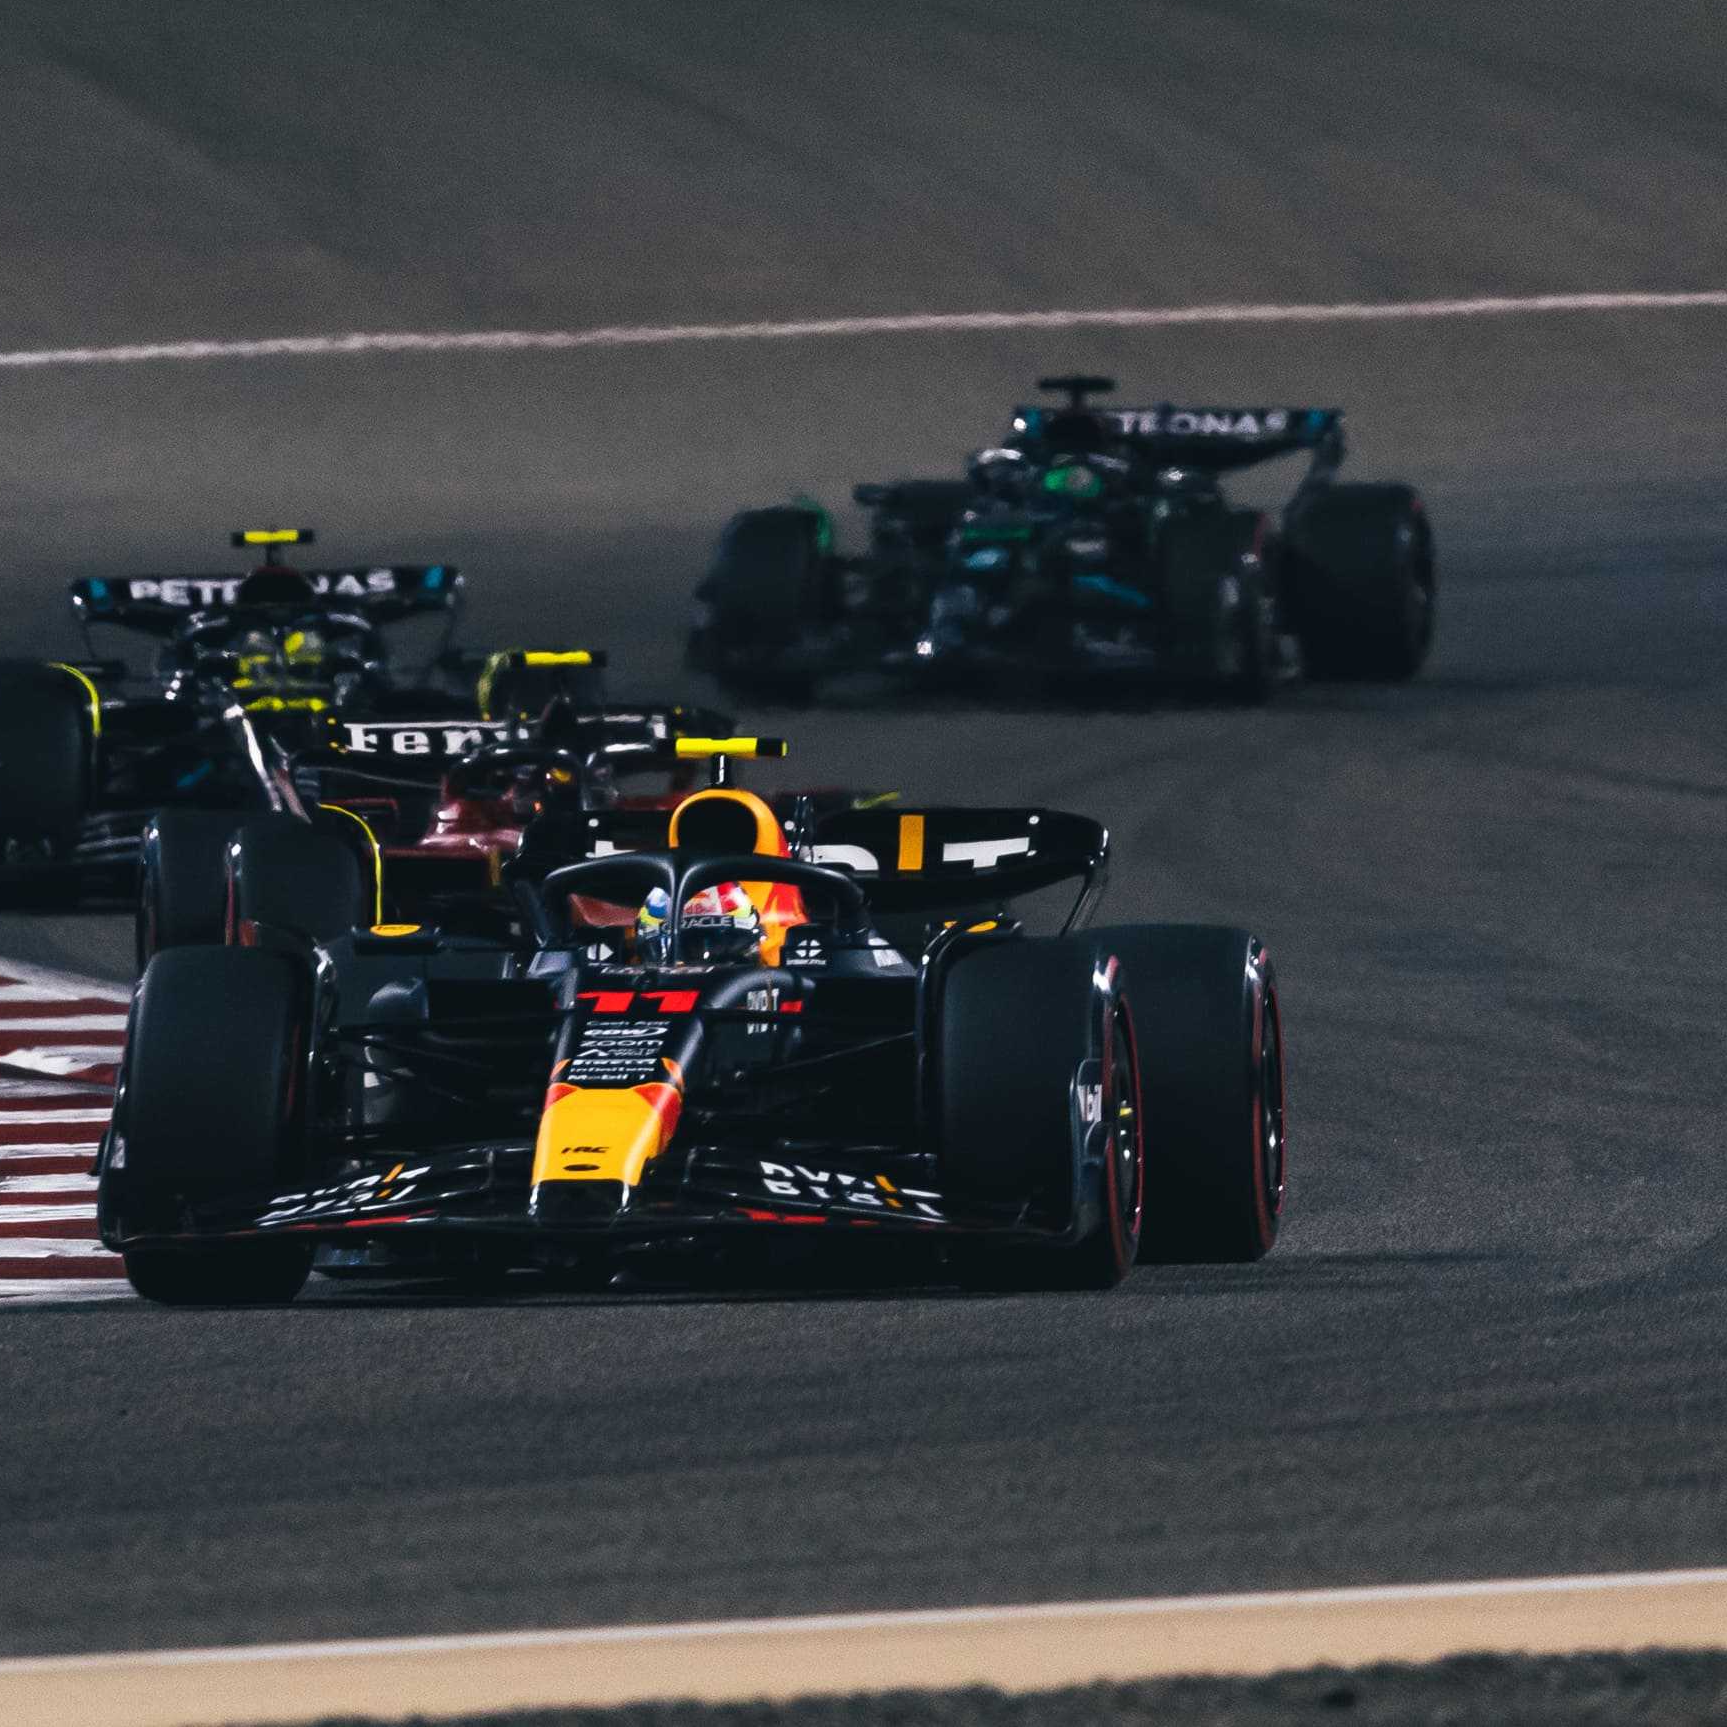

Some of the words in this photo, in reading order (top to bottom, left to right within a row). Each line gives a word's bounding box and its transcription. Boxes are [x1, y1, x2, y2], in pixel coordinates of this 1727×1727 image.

[1111, 409, 1289, 439] TRONAS
[128, 569, 396, 606] PETNAS
[576, 990, 700, 1013] 11
